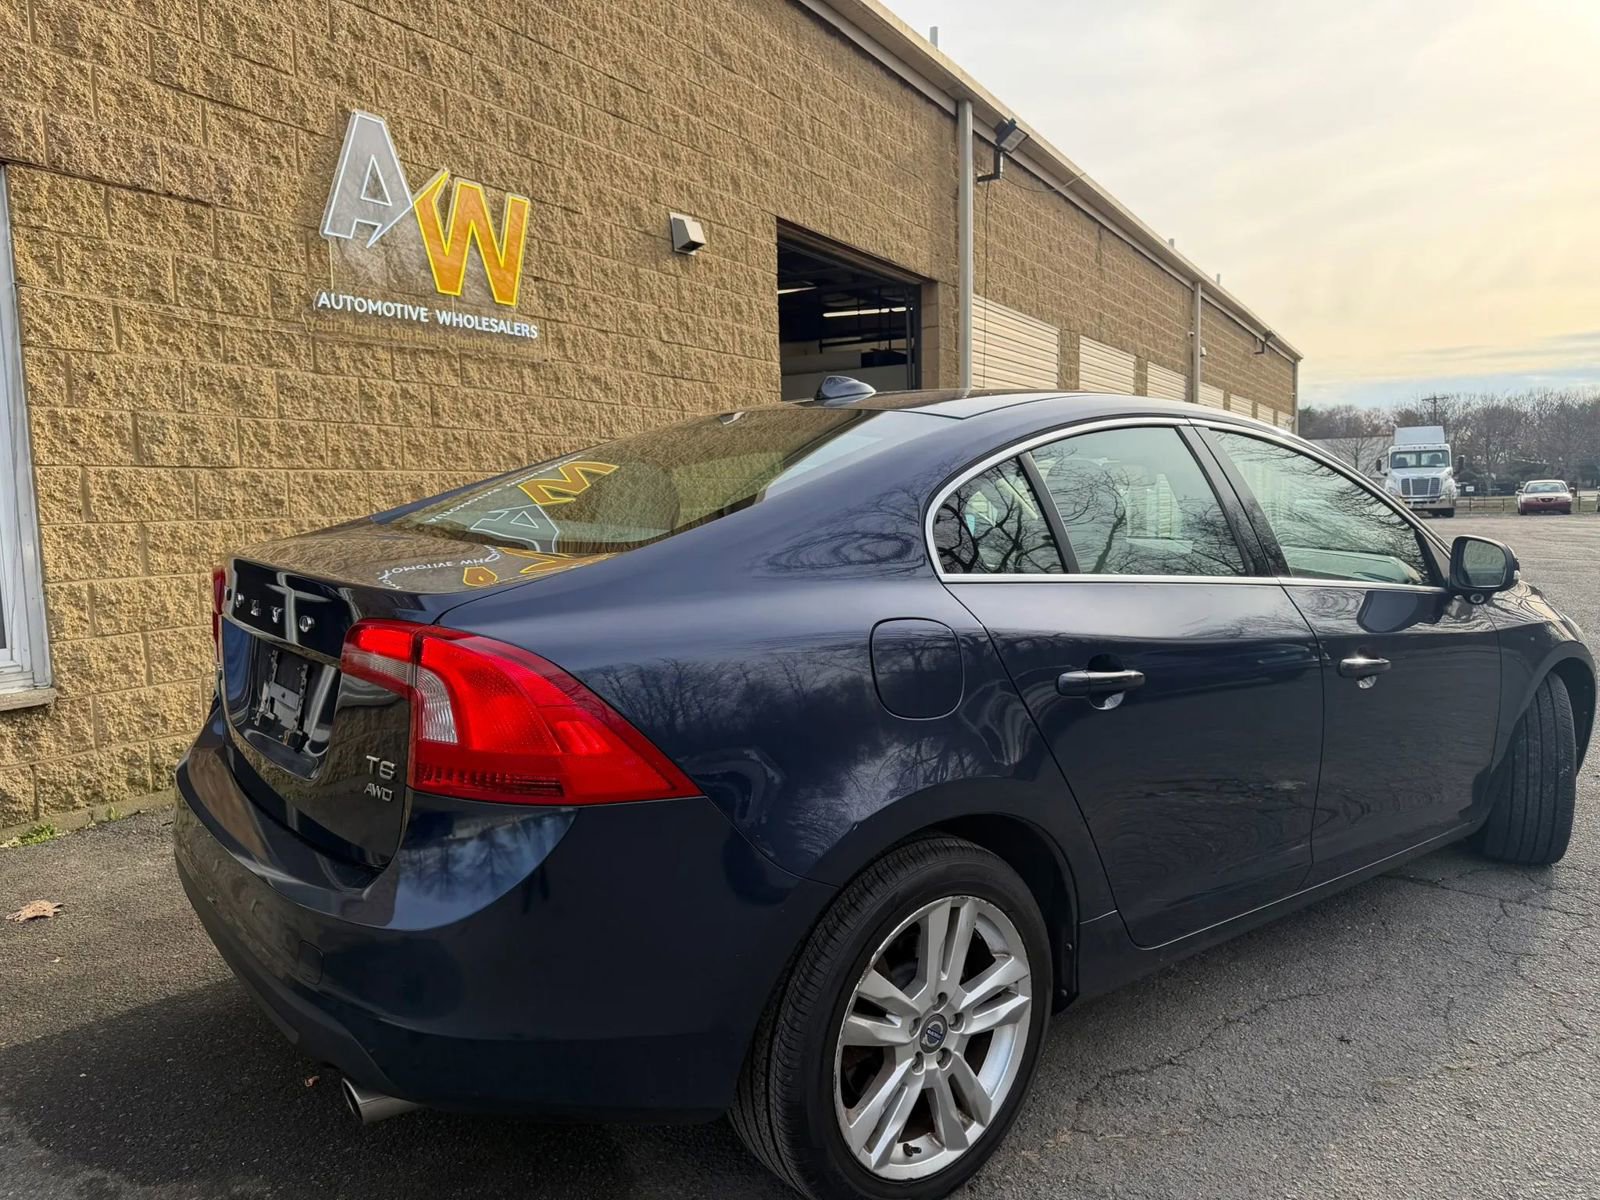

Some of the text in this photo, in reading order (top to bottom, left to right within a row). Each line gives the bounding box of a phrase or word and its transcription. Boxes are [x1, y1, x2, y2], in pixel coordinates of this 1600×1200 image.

[317, 291, 539, 340] AUTOMOTIVE WHOLESALERS
[365, 754, 396, 781] T6
[363, 782, 394, 803] AWD
